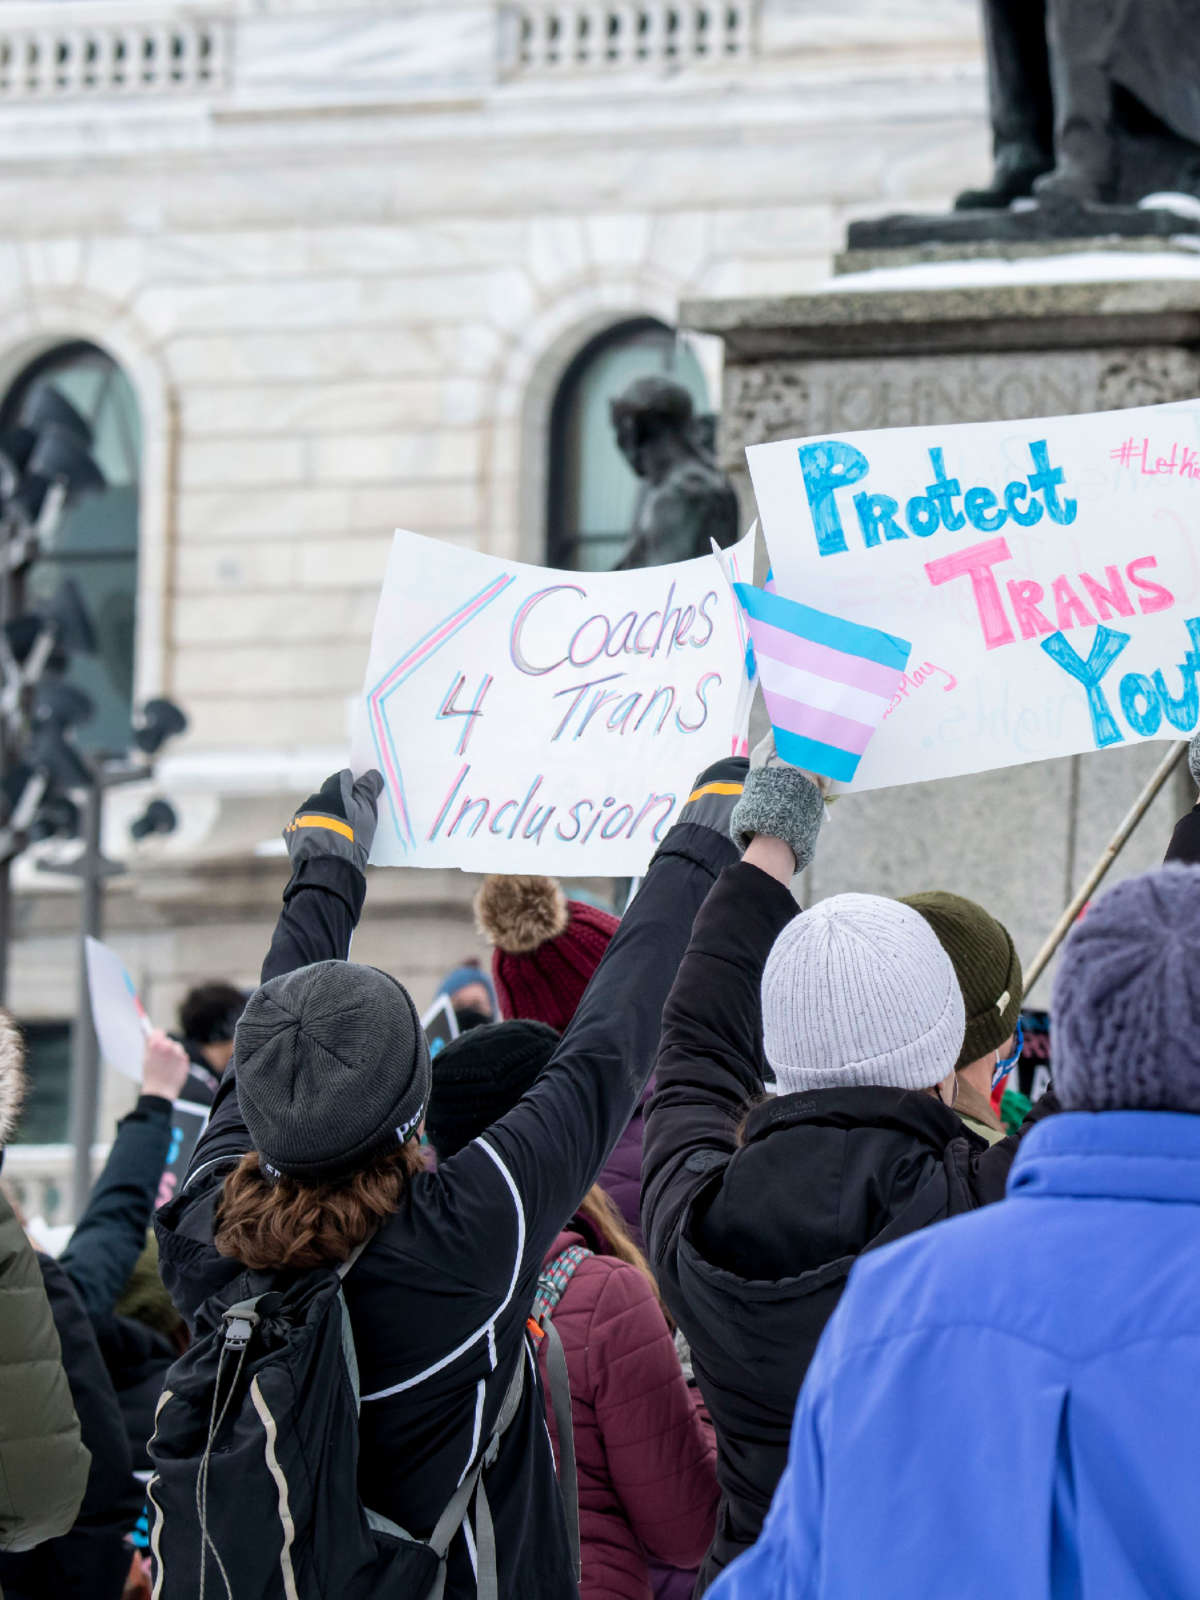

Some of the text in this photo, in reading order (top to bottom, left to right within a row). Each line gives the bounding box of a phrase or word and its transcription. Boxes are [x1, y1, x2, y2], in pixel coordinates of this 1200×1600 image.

[510, 579, 718, 677] Coaches
[924, 536, 1175, 650] TRANS
[435, 670, 722, 756] 4 Trans
[425, 762, 678, 845] Inclusion
